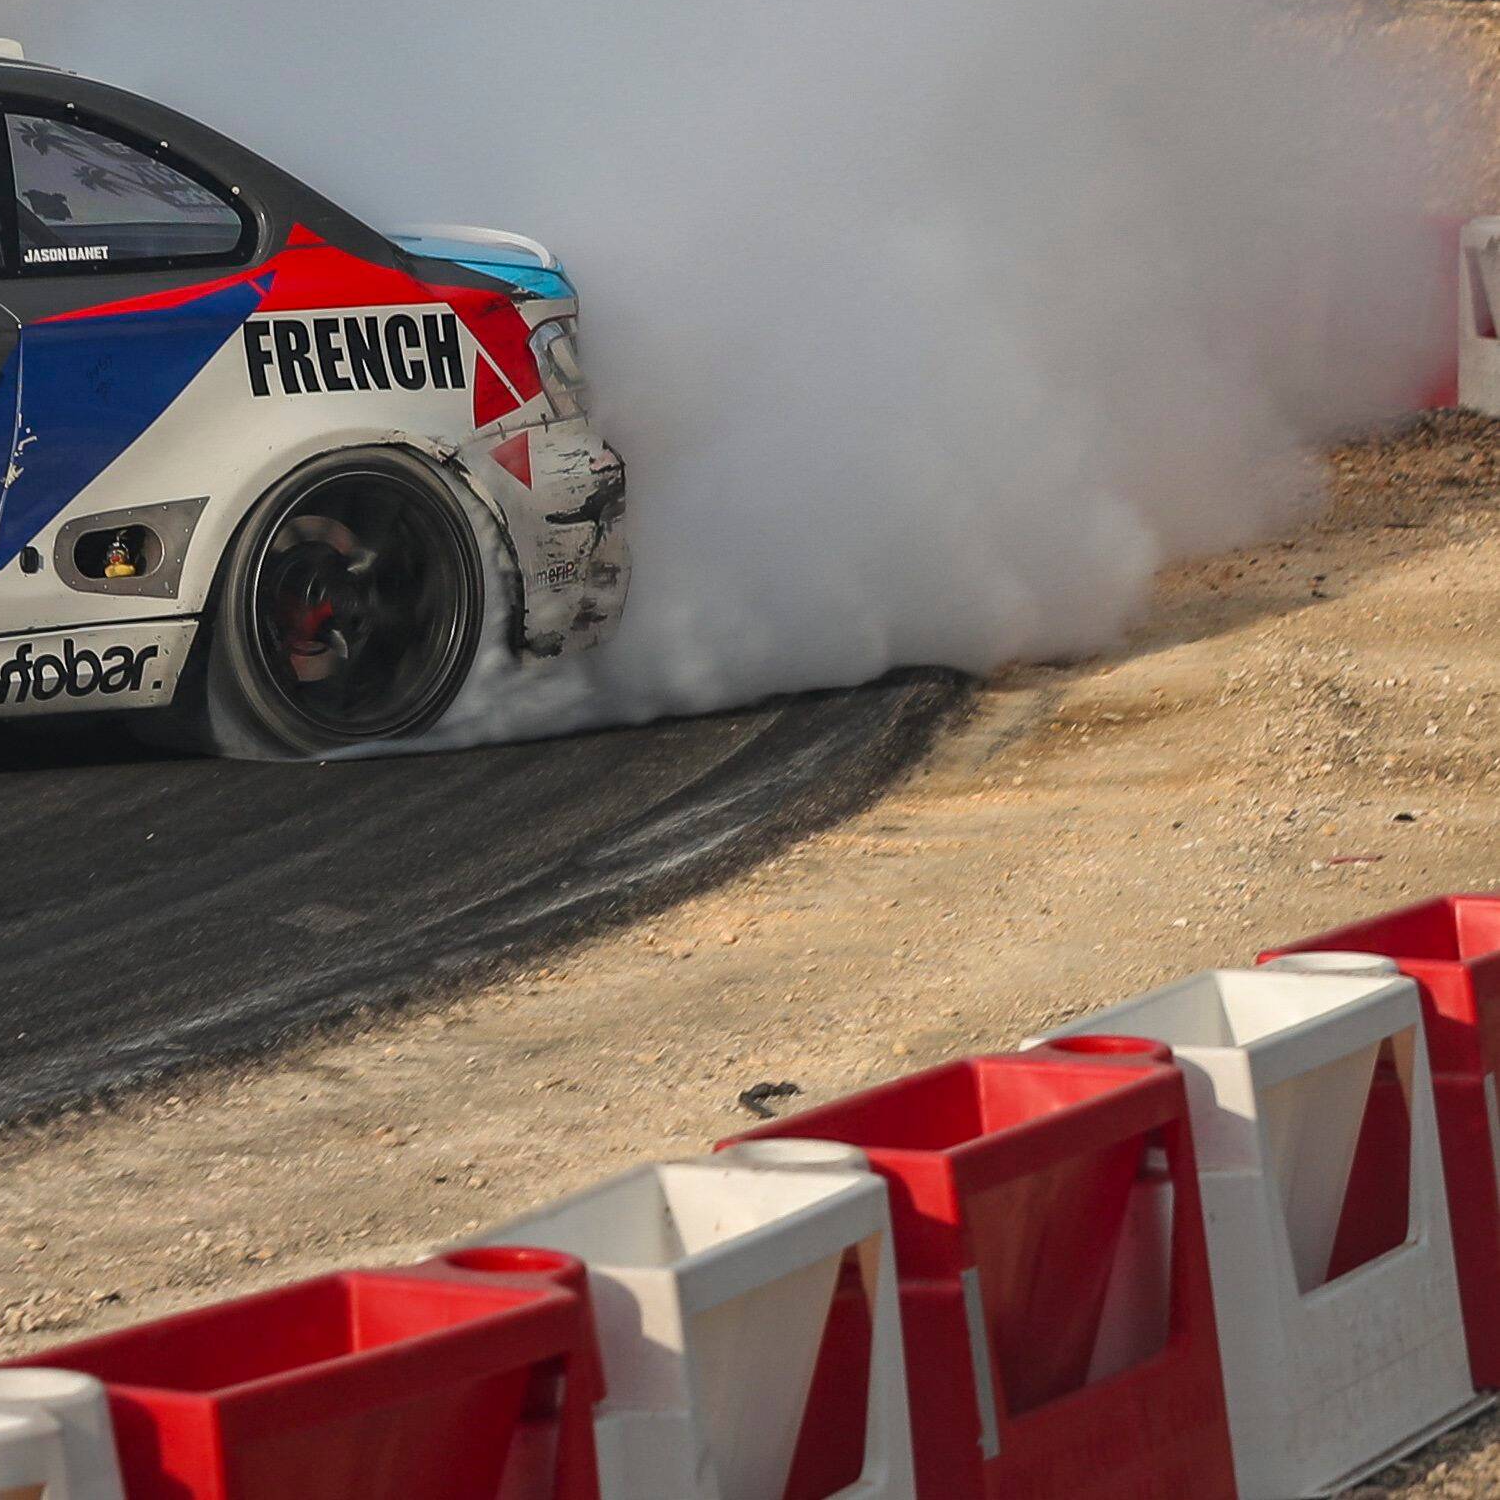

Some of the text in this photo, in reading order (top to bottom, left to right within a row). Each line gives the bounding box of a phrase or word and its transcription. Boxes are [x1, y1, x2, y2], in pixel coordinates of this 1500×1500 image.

[24, 246, 108, 264] JASON BANET
[243, 313, 467, 397] FRENCH
